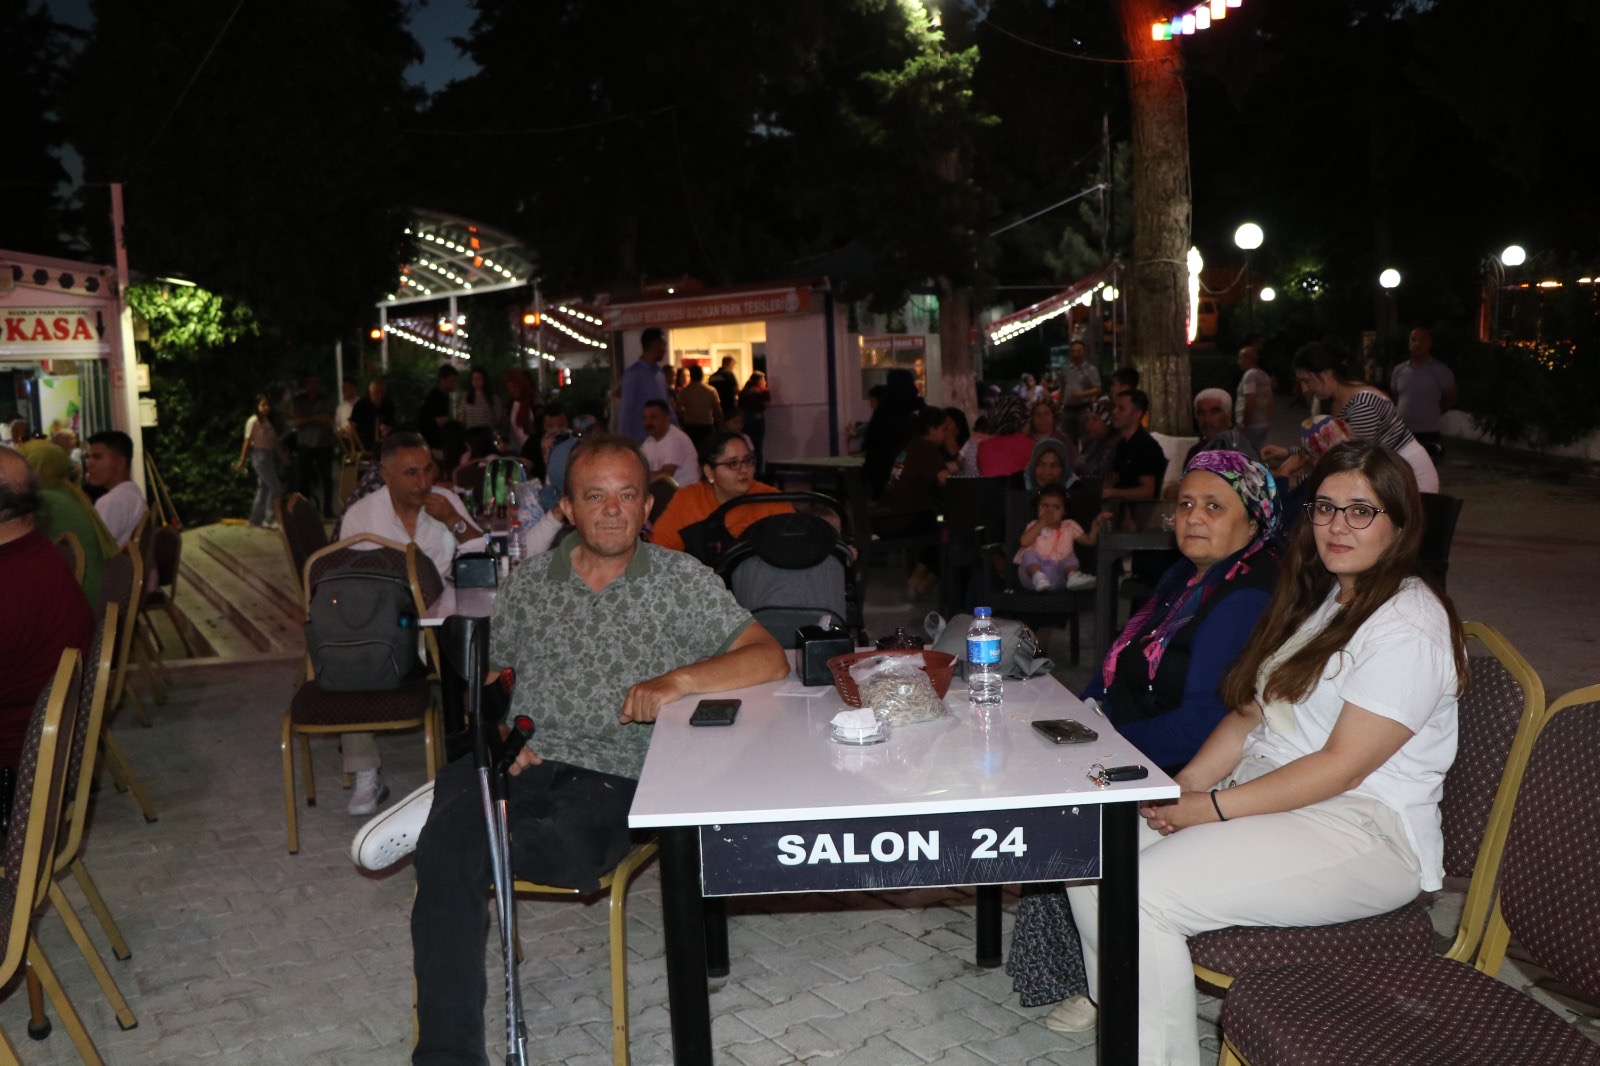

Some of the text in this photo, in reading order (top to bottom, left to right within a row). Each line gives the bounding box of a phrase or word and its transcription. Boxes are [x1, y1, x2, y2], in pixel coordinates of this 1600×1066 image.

[687, 303, 720, 319] SUÇIKAN
[721, 302, 742, 316] PARK
[743, 298, 784, 314] TESİSLERİ
[4, 317, 94, 341] KASA
[777, 826, 1028, 866] SALON 24
